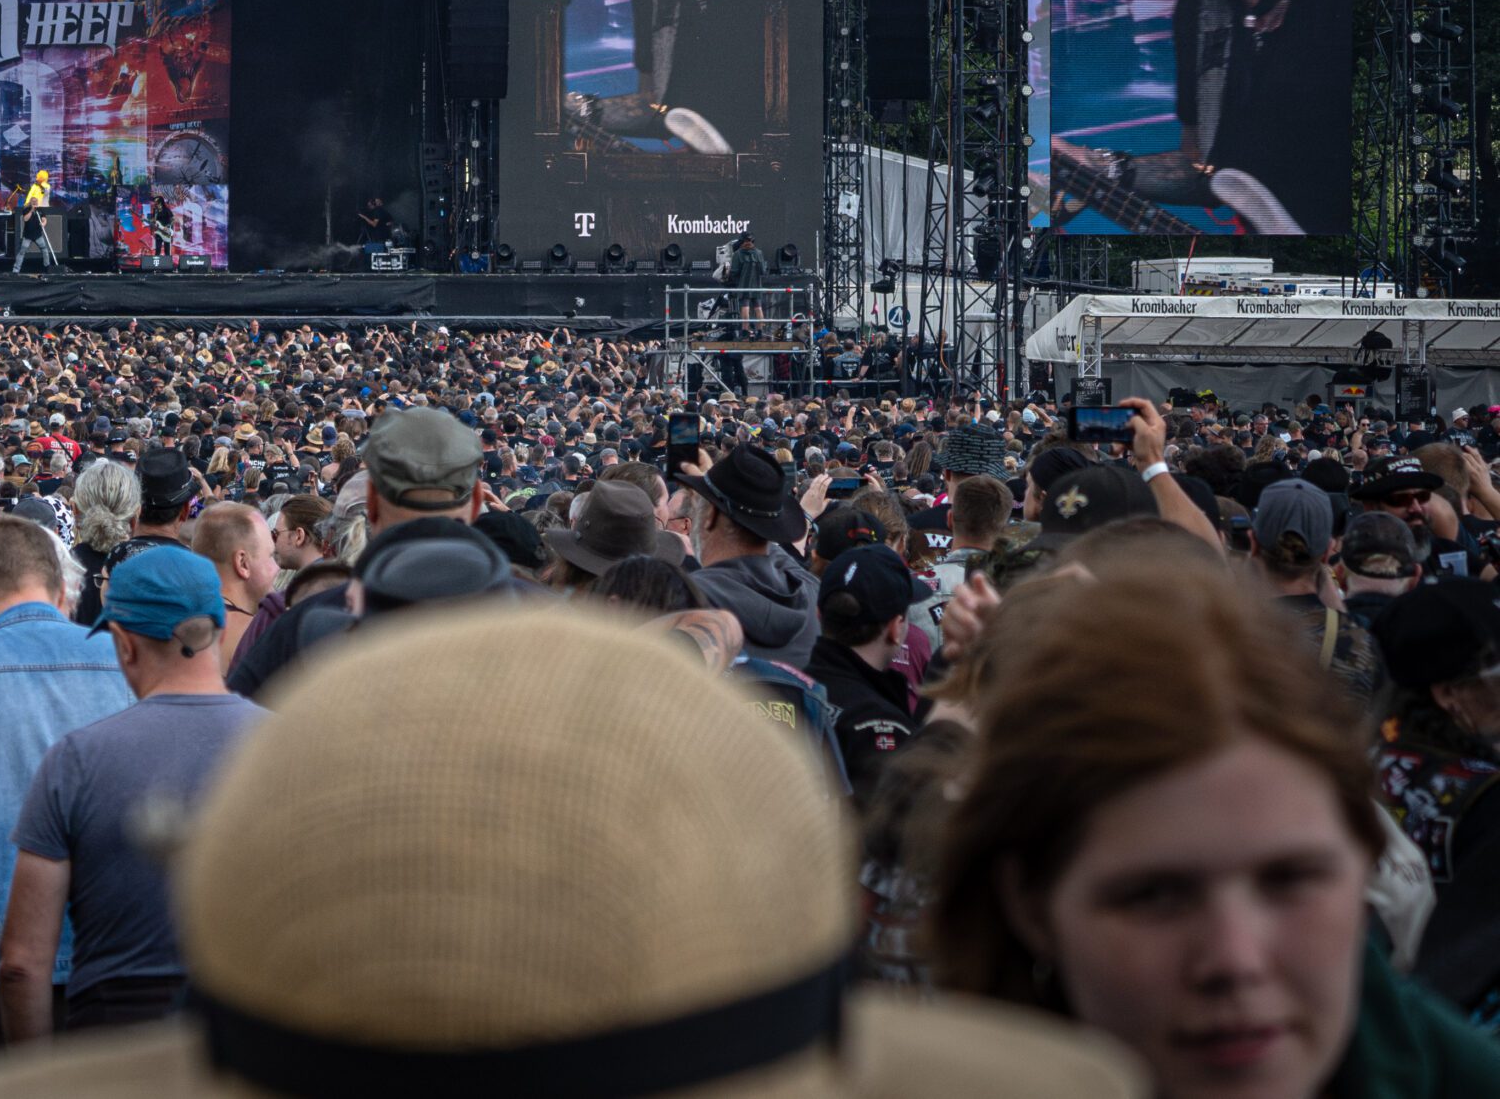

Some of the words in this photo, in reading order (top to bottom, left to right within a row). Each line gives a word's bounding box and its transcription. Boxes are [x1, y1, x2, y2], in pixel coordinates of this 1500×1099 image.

[26, 2, 135, 56] HEEP
[667, 214, 750, 234] Krombacher
[1132, 298, 1197, 314] Krombacher
[1237, 298, 1301, 314] Krombacher
[1342, 300, 1407, 316] Krombacher
